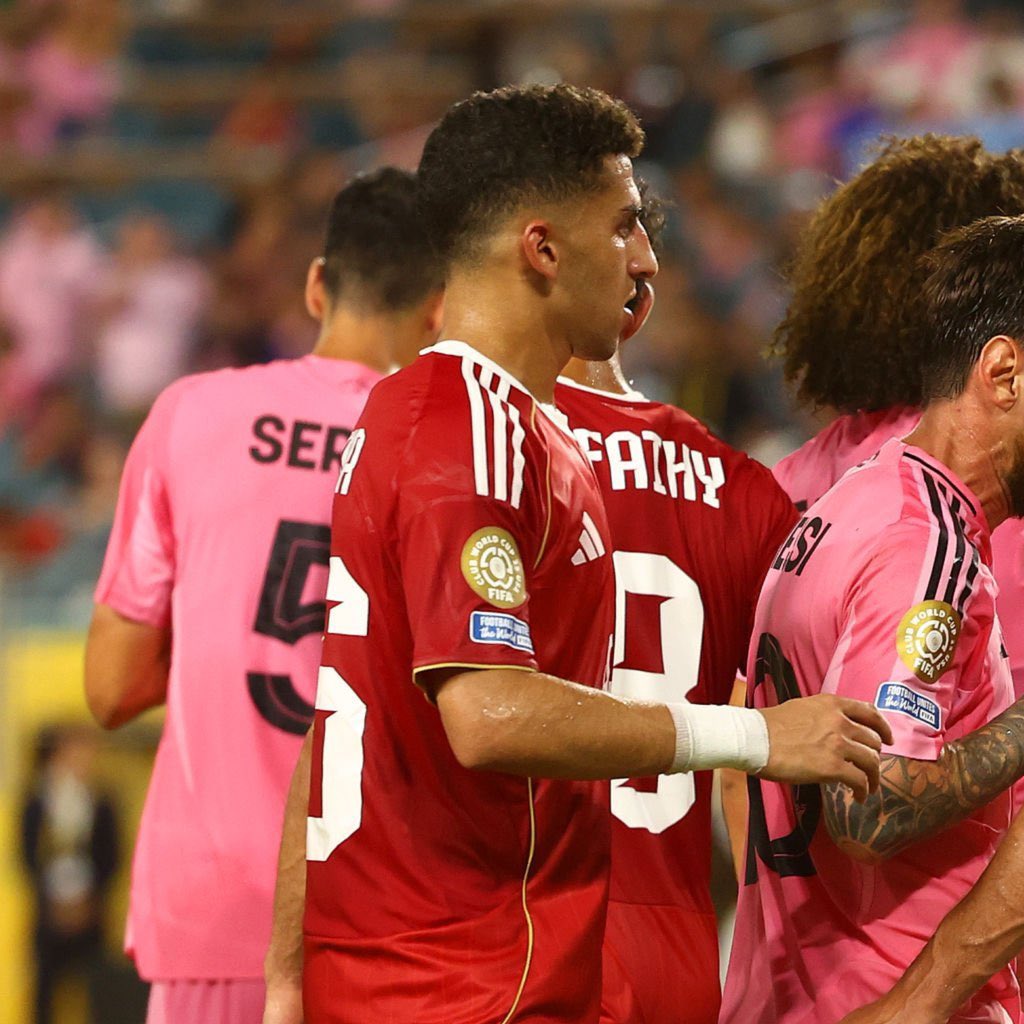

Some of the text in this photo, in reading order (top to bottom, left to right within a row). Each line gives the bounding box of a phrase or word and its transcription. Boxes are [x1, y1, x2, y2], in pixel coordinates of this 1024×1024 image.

[573, 428, 725, 508] FATHY
[470, 535, 499, 556] WORLD
[500, 539, 515, 555] CUP
[488, 588, 515, 602] FIFA
[247, 520, 331, 736] 5
[904, 627, 914, 654] CLUB
[910, 608, 946, 625] WORLD
[947, 616, 957, 635] CUP
[914, 657, 934, 678] FIFA
[887, 686, 935, 713] FOOTBALL UNITES
[921, 711, 934, 722] FIFA
